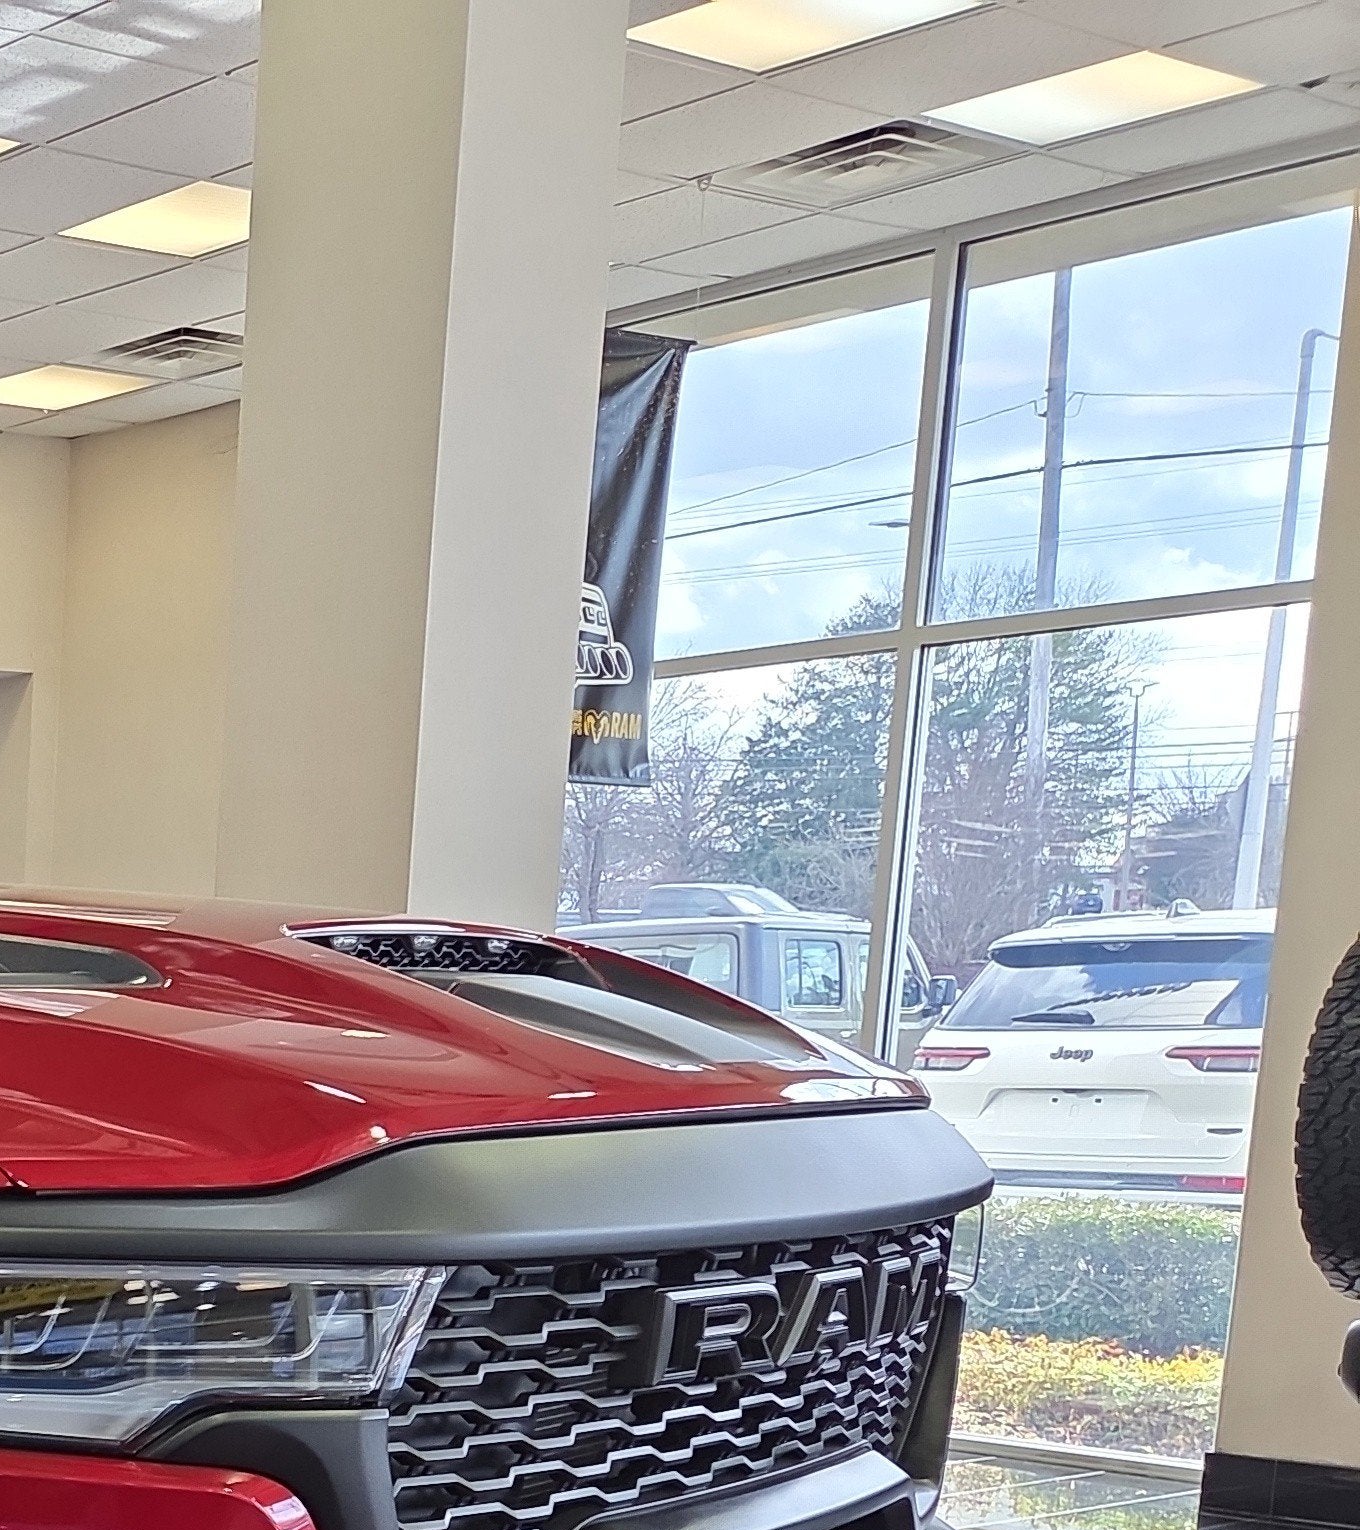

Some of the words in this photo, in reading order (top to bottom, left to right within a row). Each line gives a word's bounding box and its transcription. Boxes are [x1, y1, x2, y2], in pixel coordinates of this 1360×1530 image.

[611, 711, 643, 740] RAM
[1049, 1046, 1094, 1062] Jeep
[652, 1248, 943, 1386] RAM
